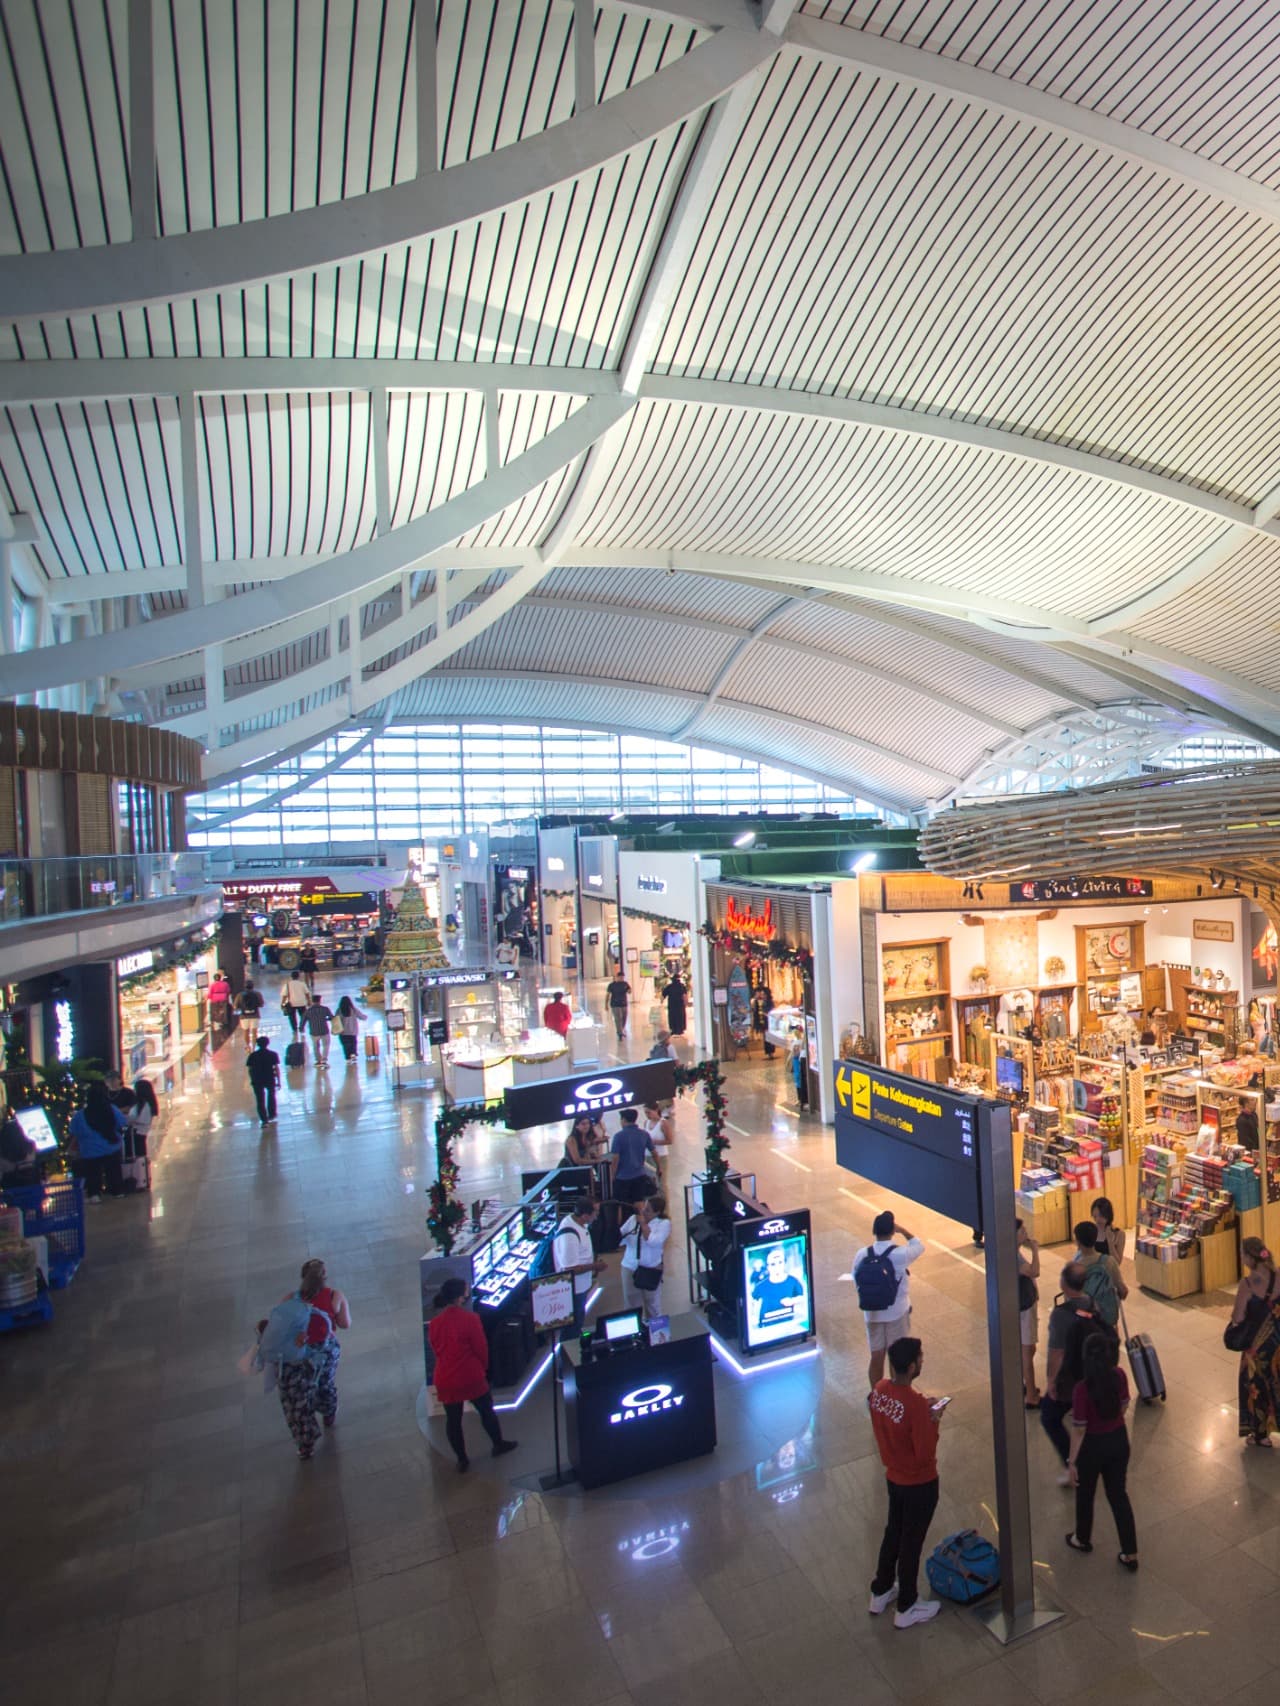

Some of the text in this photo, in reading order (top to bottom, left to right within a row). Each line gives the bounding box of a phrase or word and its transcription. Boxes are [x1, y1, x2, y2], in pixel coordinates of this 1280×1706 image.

[247, 884, 276, 894] DUTY
[277, 883, 302, 893] FREE
[438, 973, 486, 985] SWAROVSKI
[872, 1080, 889, 1099] Pintu
[564, 1092, 635, 1115] OAKLEY
[897, 1117, 913, 1134] Gates
[610, 1395, 684, 1424] OAKLEY
